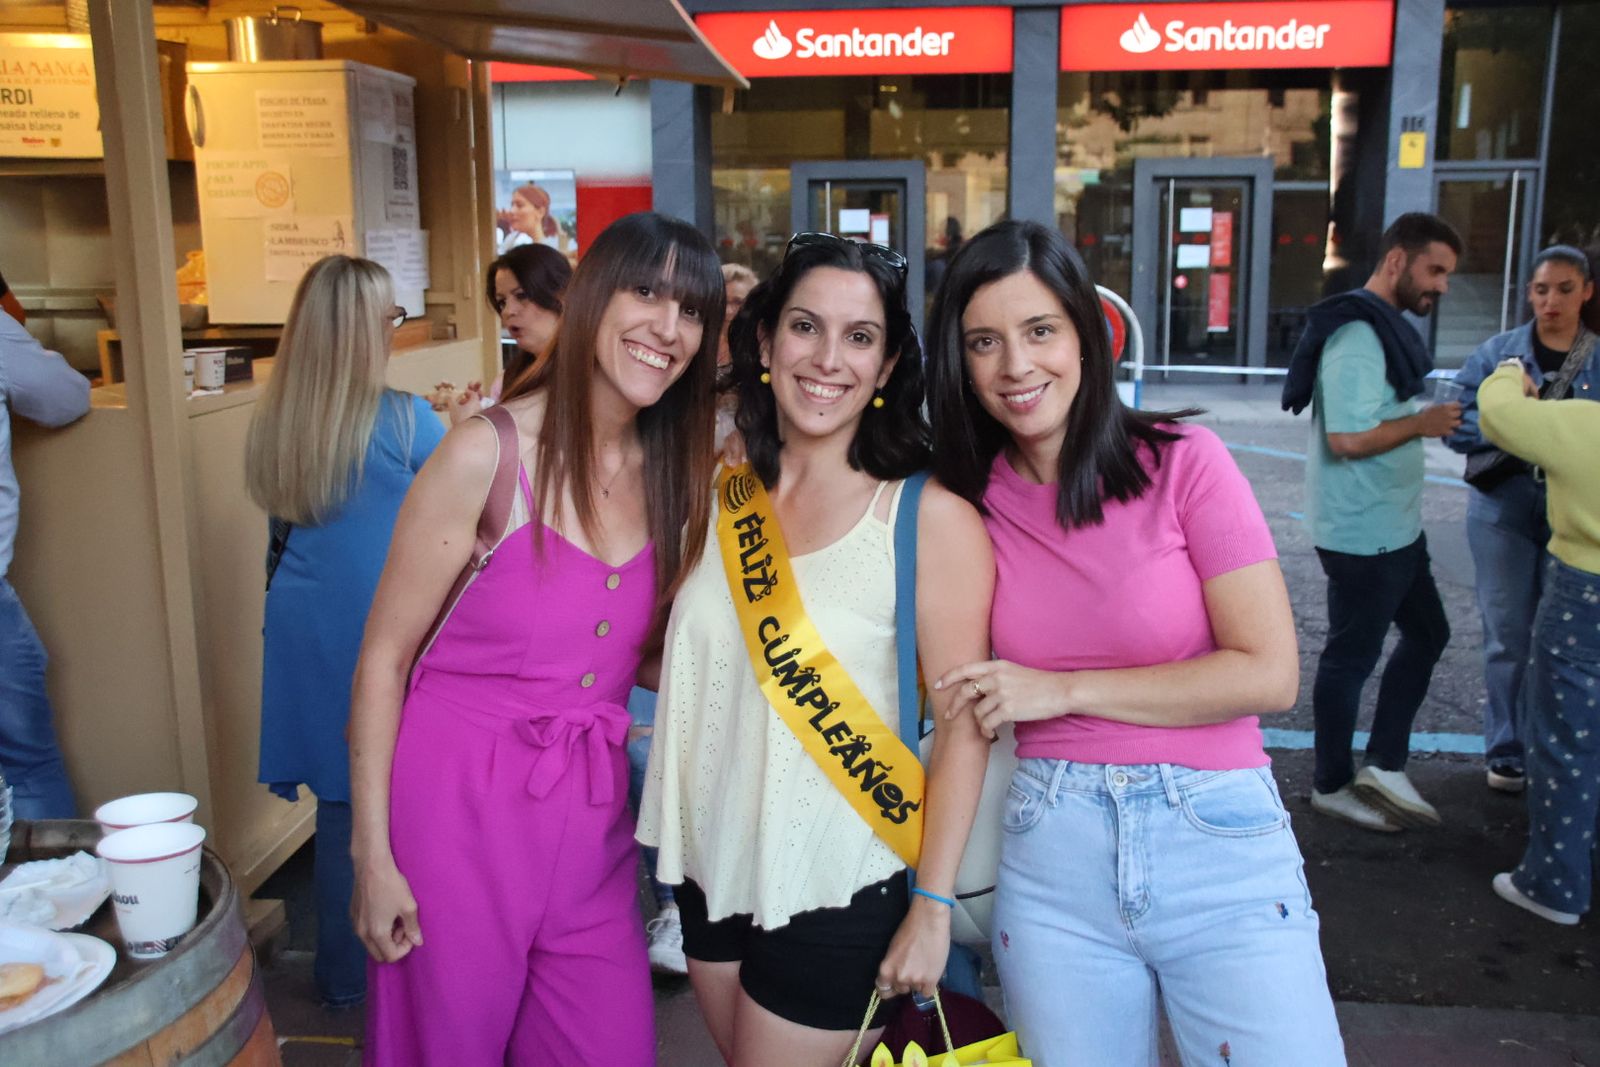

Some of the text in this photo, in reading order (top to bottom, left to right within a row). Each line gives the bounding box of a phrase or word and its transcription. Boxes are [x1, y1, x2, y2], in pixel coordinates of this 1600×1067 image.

[796, 26, 955, 58] Santander
[1164, 18, 1331, 52] Santander
[0, 60, 90, 76] LAMANCA
[0, 109, 26, 118] eada
[29, 119, 63, 131] blanca
[733, 511, 922, 825] FELIZ CUMPLEAÑOS
